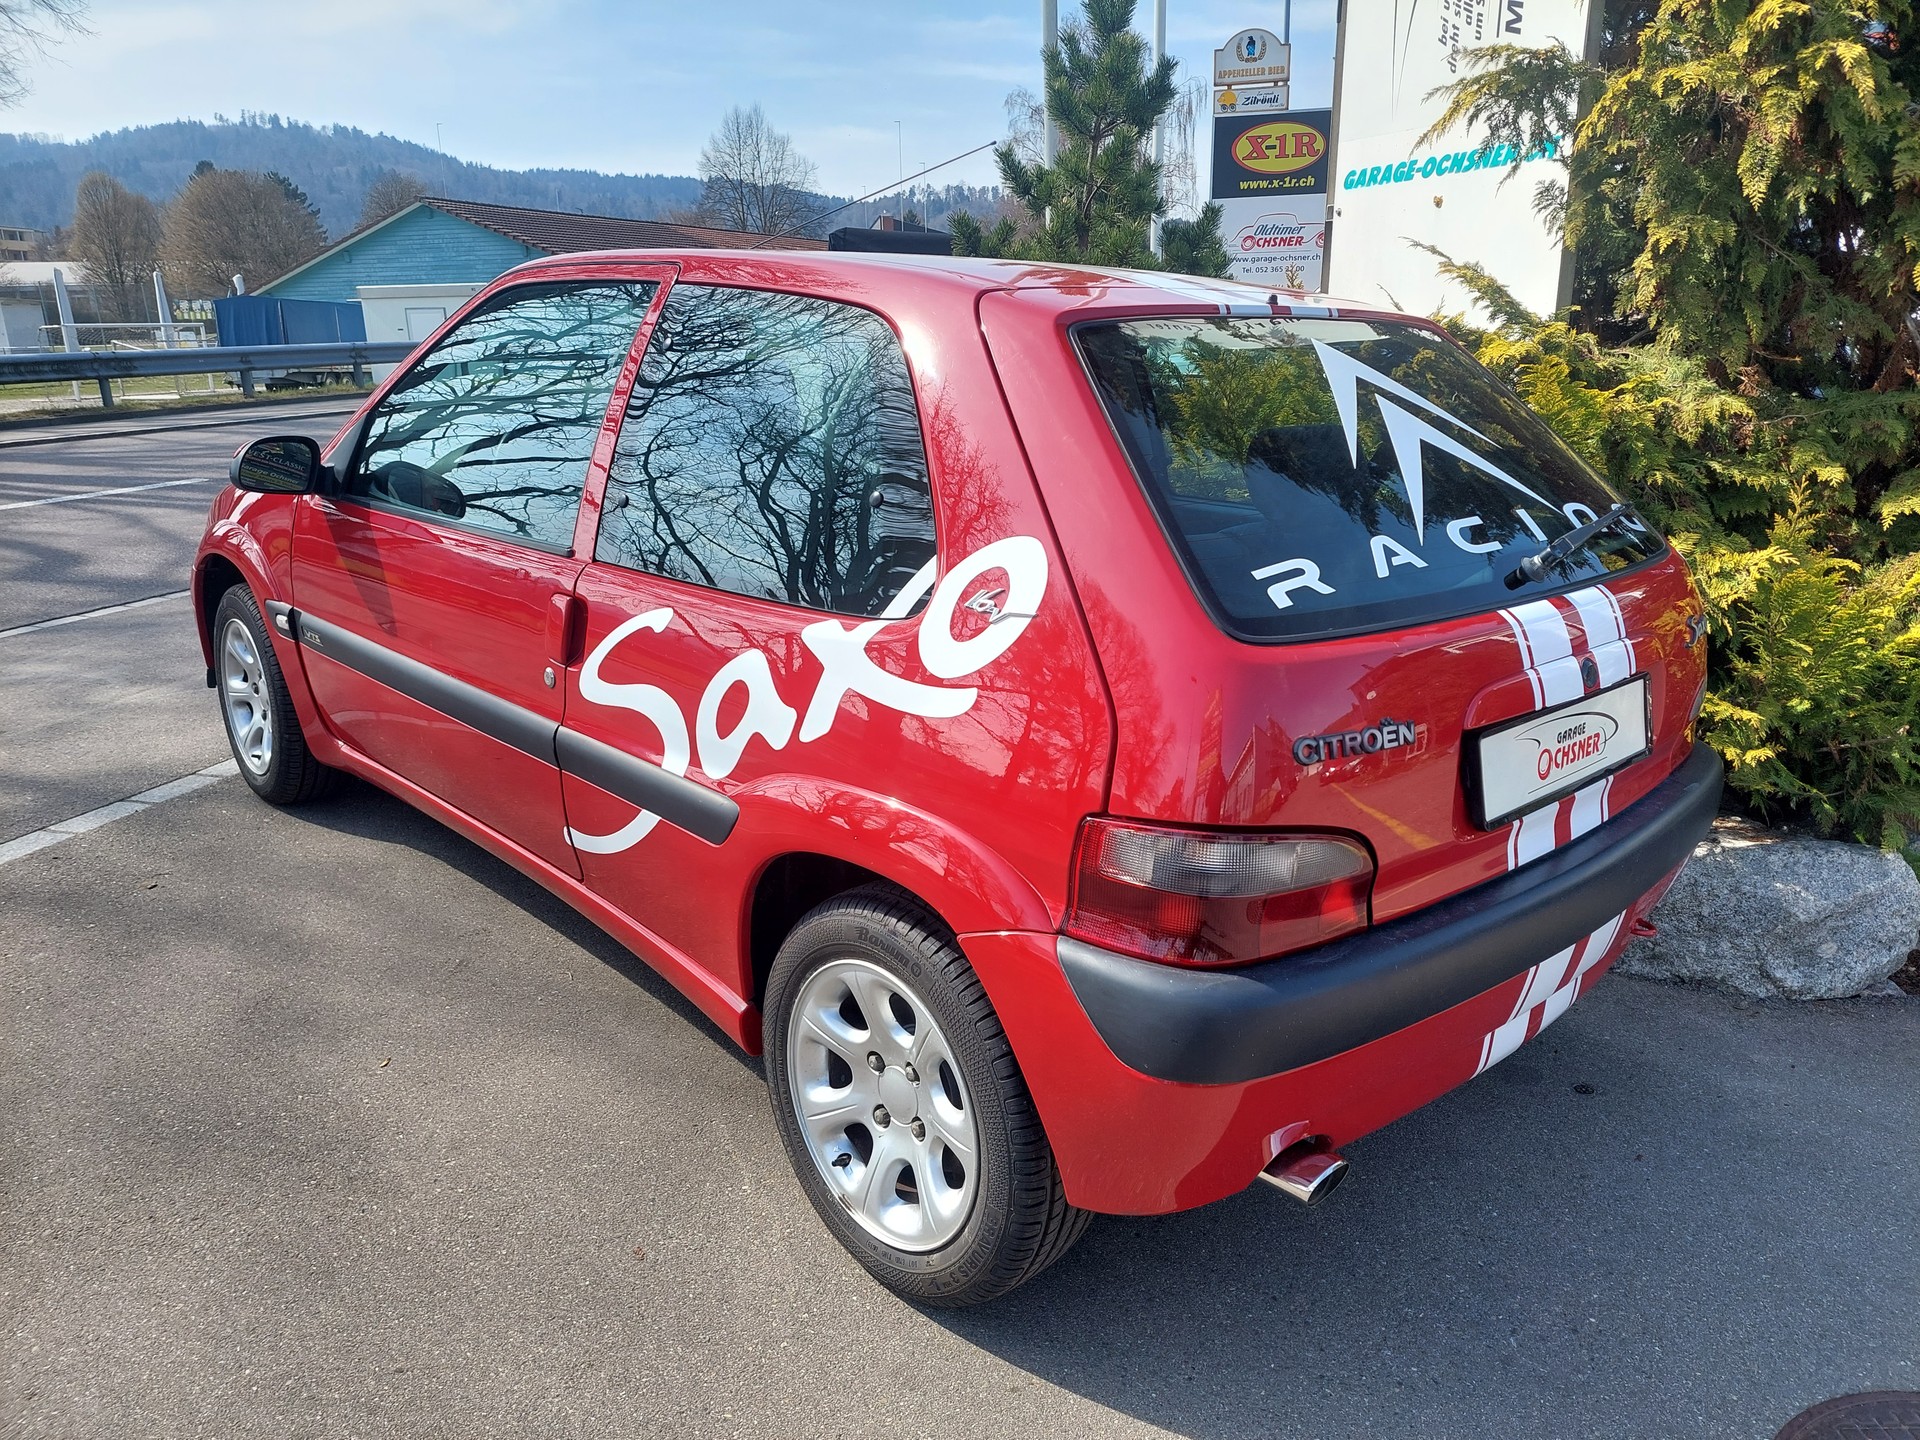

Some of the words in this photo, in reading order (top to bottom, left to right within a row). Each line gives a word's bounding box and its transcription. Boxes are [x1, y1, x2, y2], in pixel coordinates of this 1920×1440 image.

[1217, 67, 1266, 79] APPENZELLER
[1267, 65, 1286, 76] BIER
[1241, 94, 1280, 106] Zitrönli
[1241, 132, 1321, 161] X-1R
[1239, 175, 1315, 190] www.x-1r.ch
[1254, 223, 1306, 237] Oldtimer
[1241, 235, 1305, 252] OCHSNER
[1255, 266, 1269, 274] 052
[1270, 265, 1284, 273] 365
[563, 535, 1049, 854] Saxo
[1292, 716, 1416, 767] CITROËN
[1556, 721, 1587, 745] GARAGE
[1537, 731, 1602, 781] OCHSNER
